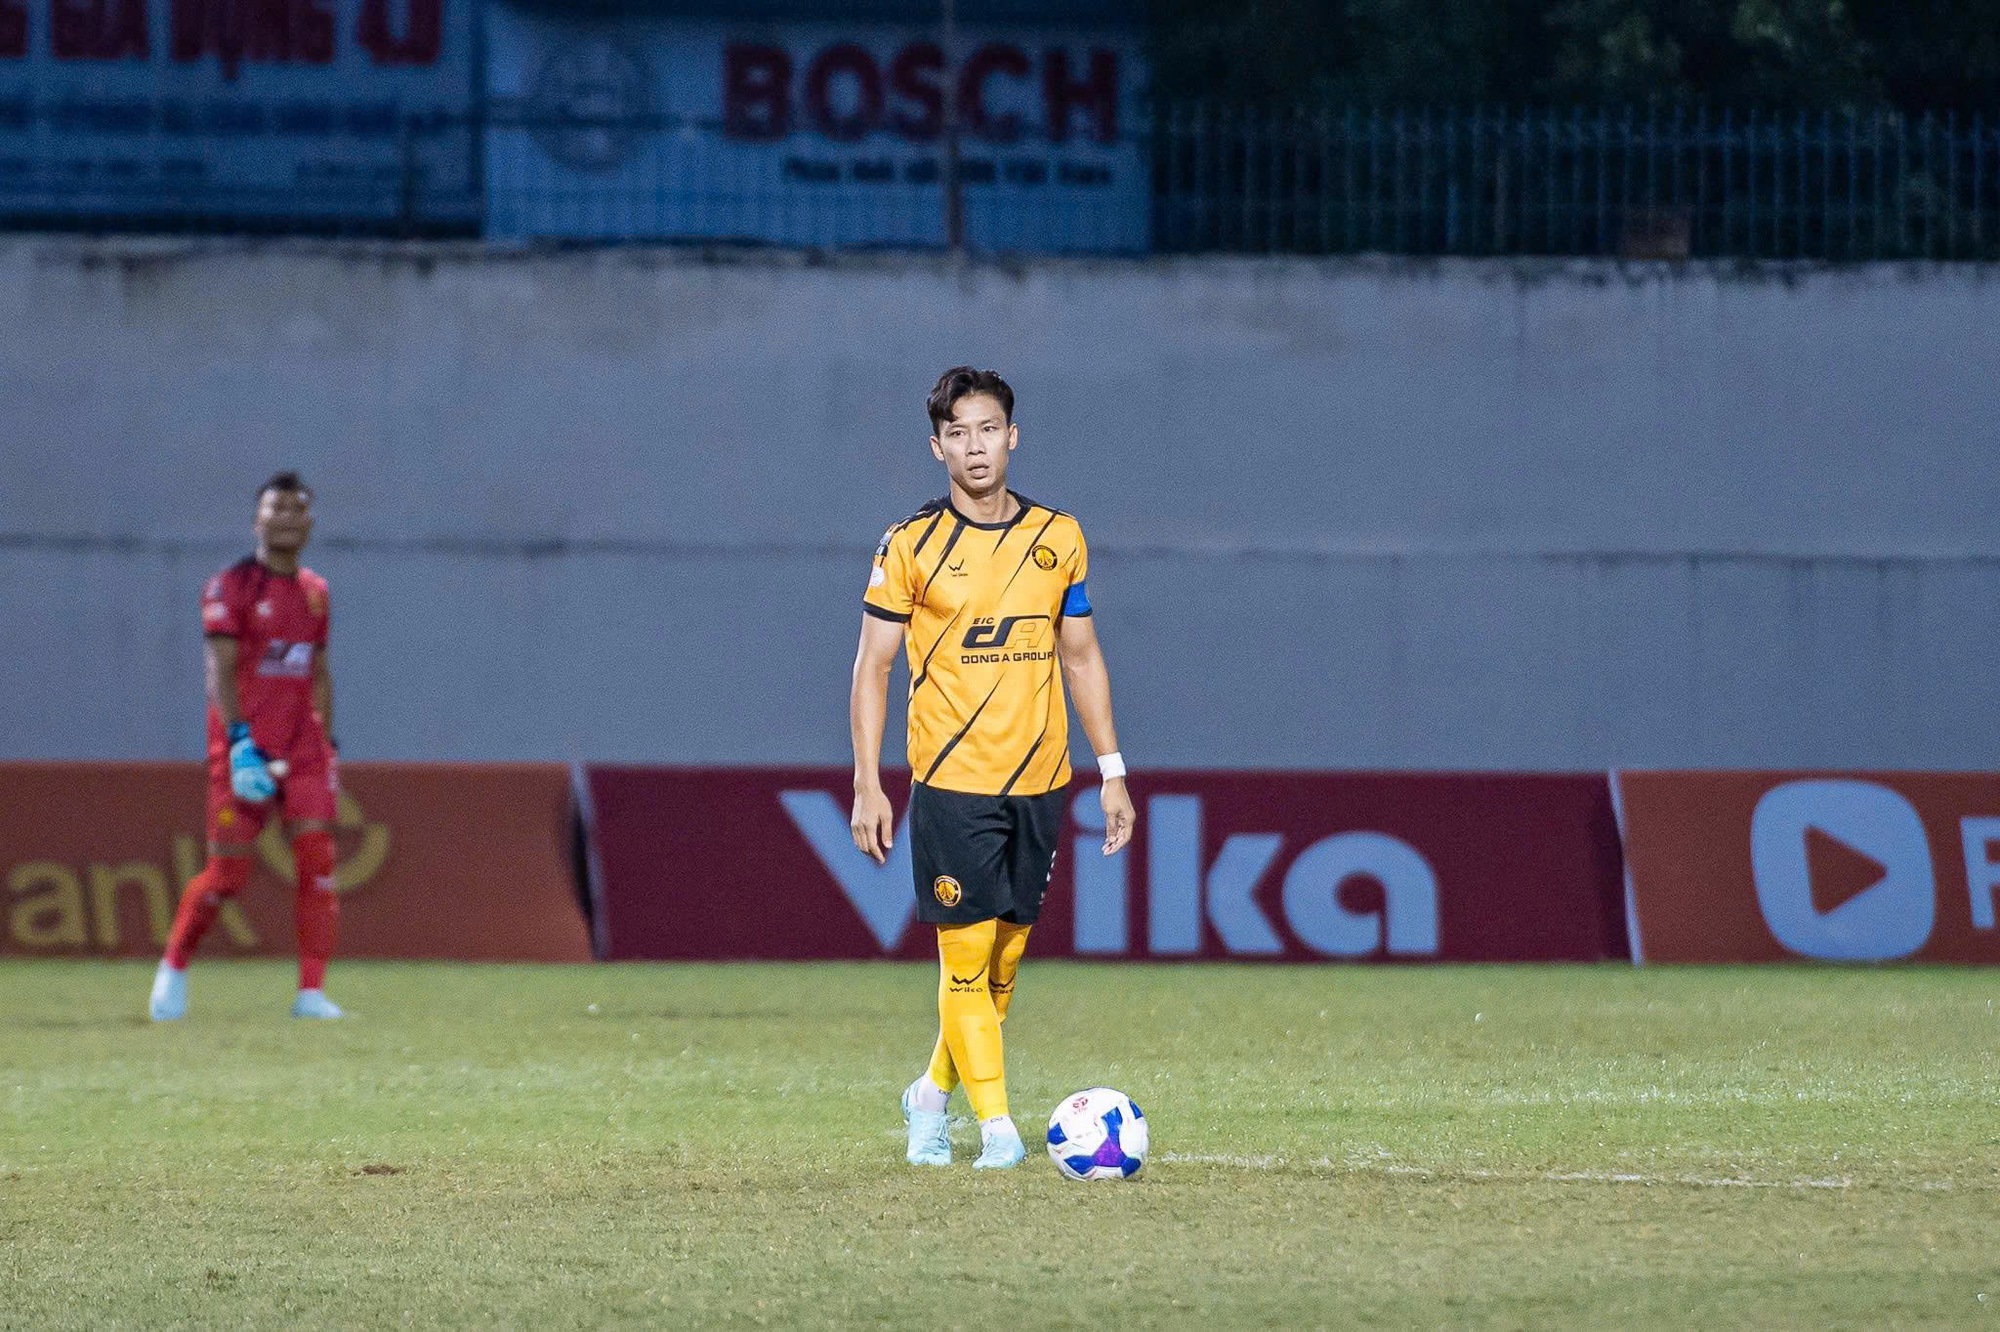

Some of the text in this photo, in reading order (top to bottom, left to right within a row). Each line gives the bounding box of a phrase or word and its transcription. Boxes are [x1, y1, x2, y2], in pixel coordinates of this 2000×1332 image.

[724, 44, 1117, 141] BOSCH
[973, 617, 994, 625] EIC
[961, 651, 1054, 664] DONG A GROUP
